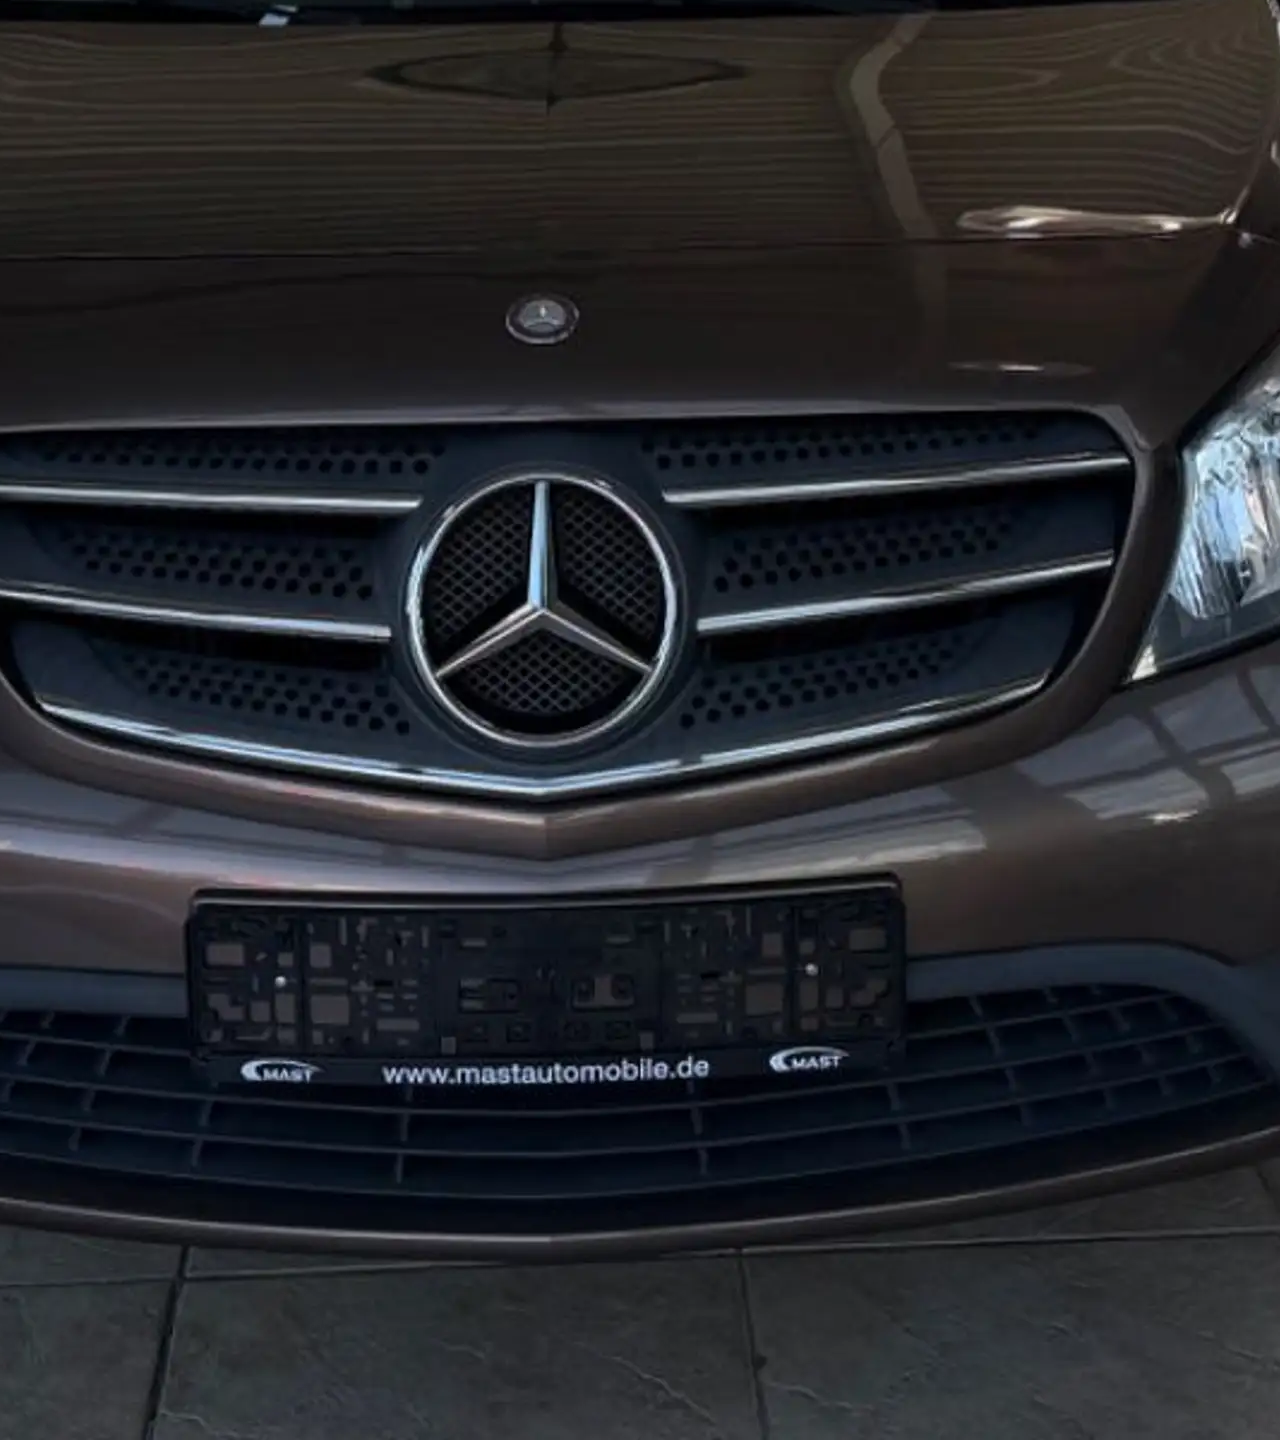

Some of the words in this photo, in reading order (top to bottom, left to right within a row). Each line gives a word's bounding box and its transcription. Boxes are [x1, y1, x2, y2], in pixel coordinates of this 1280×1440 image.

[263, 1067, 313, 1083] MAST
[382, 1054, 709, 1085] www.mastautomobile.de
[790, 1054, 841, 1071] MAST
